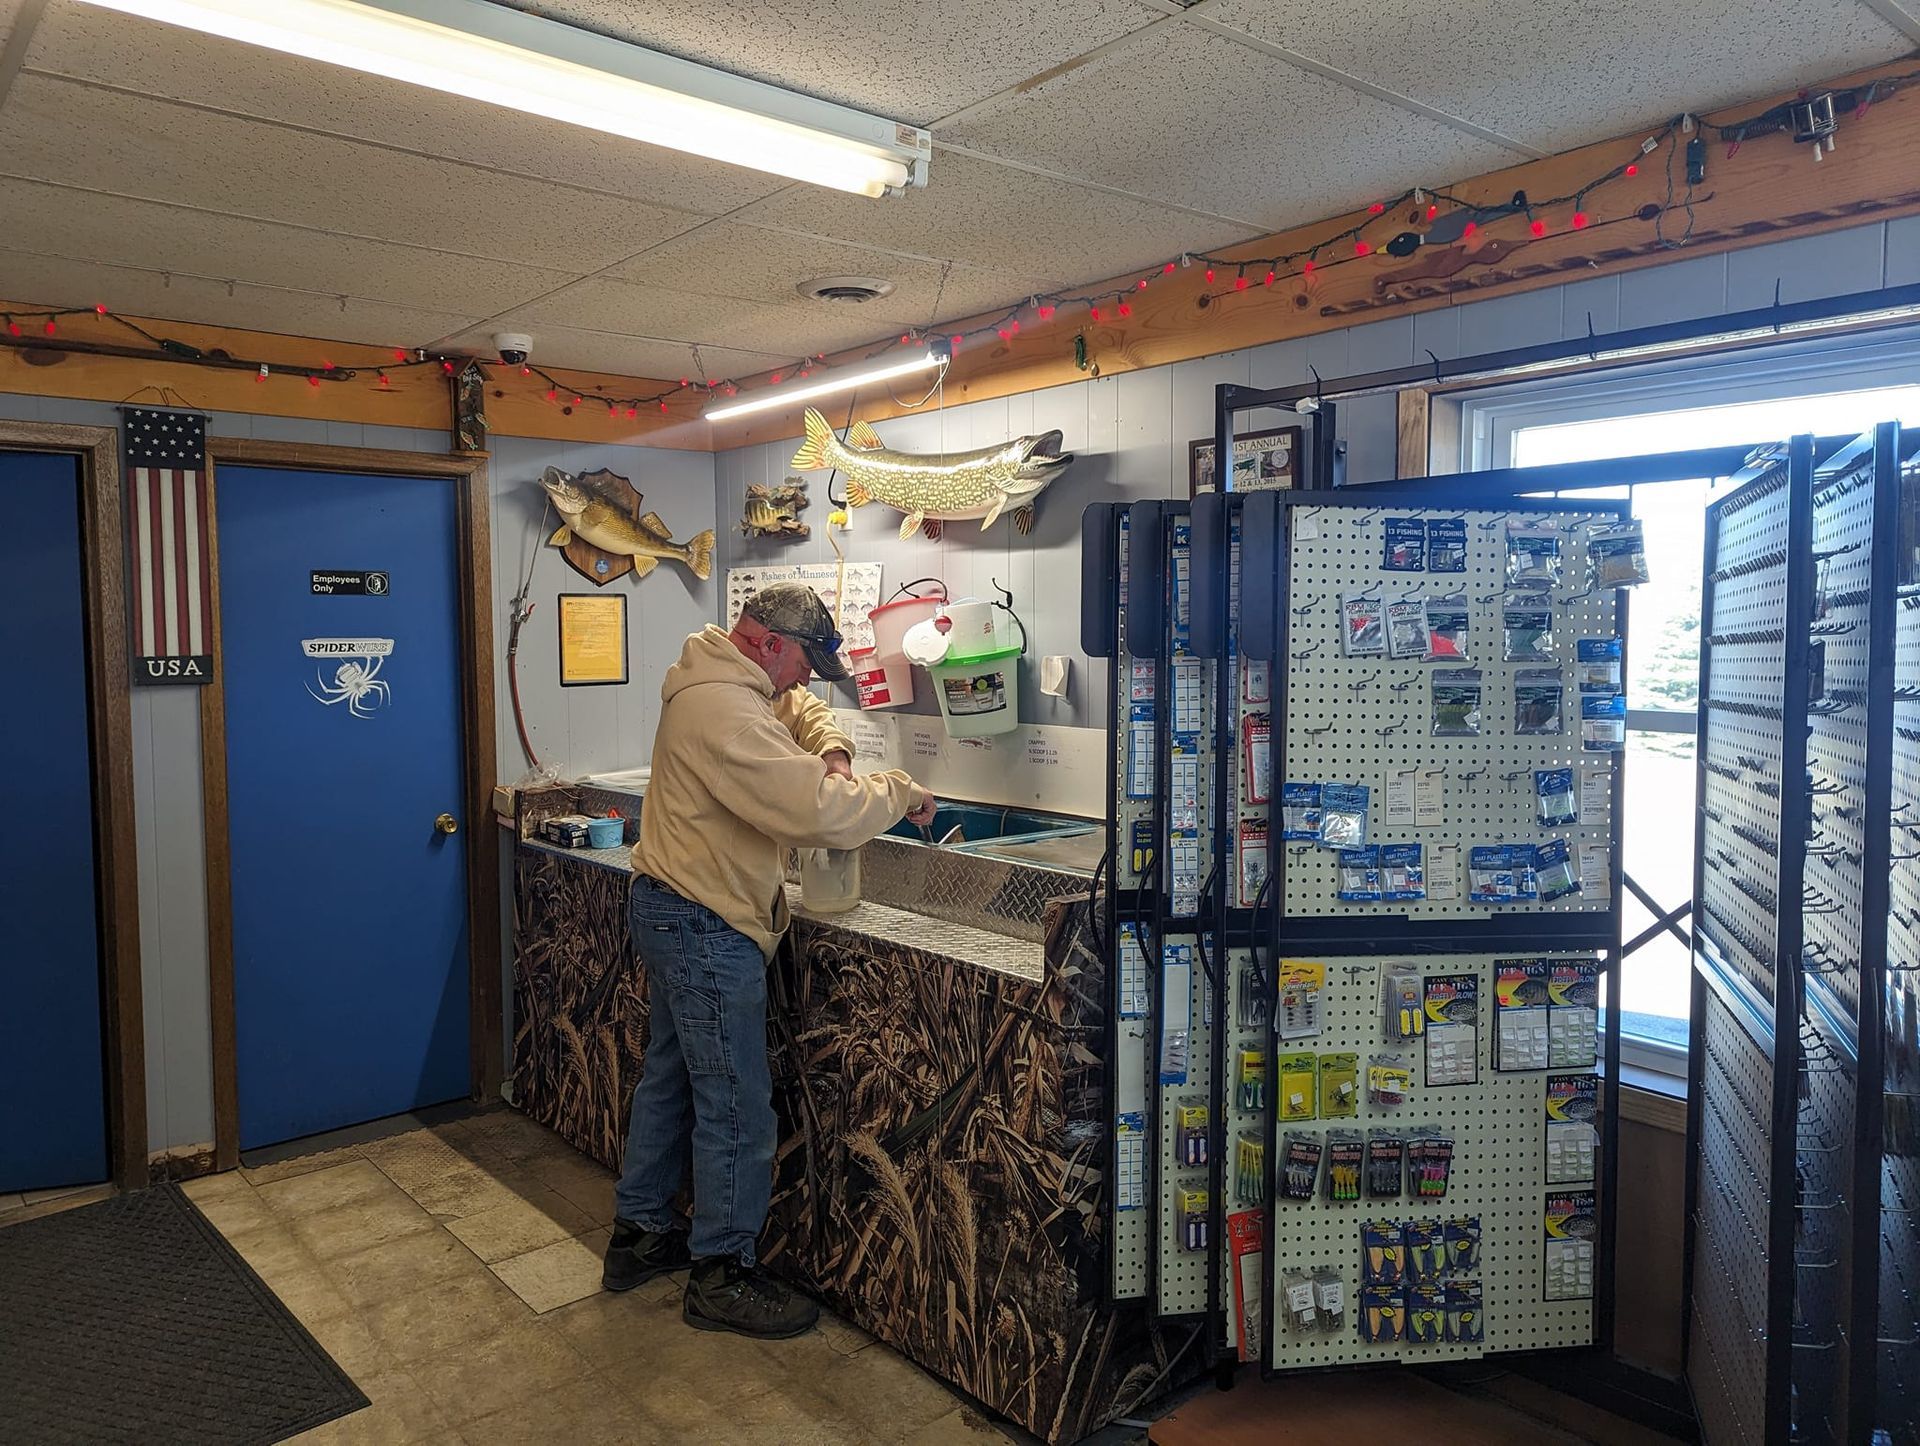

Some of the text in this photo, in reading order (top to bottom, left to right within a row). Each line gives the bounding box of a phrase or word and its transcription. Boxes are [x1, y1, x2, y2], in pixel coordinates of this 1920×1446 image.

[1251, 436, 1287, 449] ANNUAL
[313, 574, 360, 585] Employees
[761, 572, 786, 581] Fishes
[799, 570, 838, 580] Minnesot
[313, 584, 334, 593] Only
[308, 642, 391, 653] SPIDERWIRE
[147, 659, 202, 677] USA
[1297, 790, 1318, 798] PLASTICS
[1356, 851, 1376, 859] PLASTICS
[1398, 850, 1418, 858] PLASTICS
